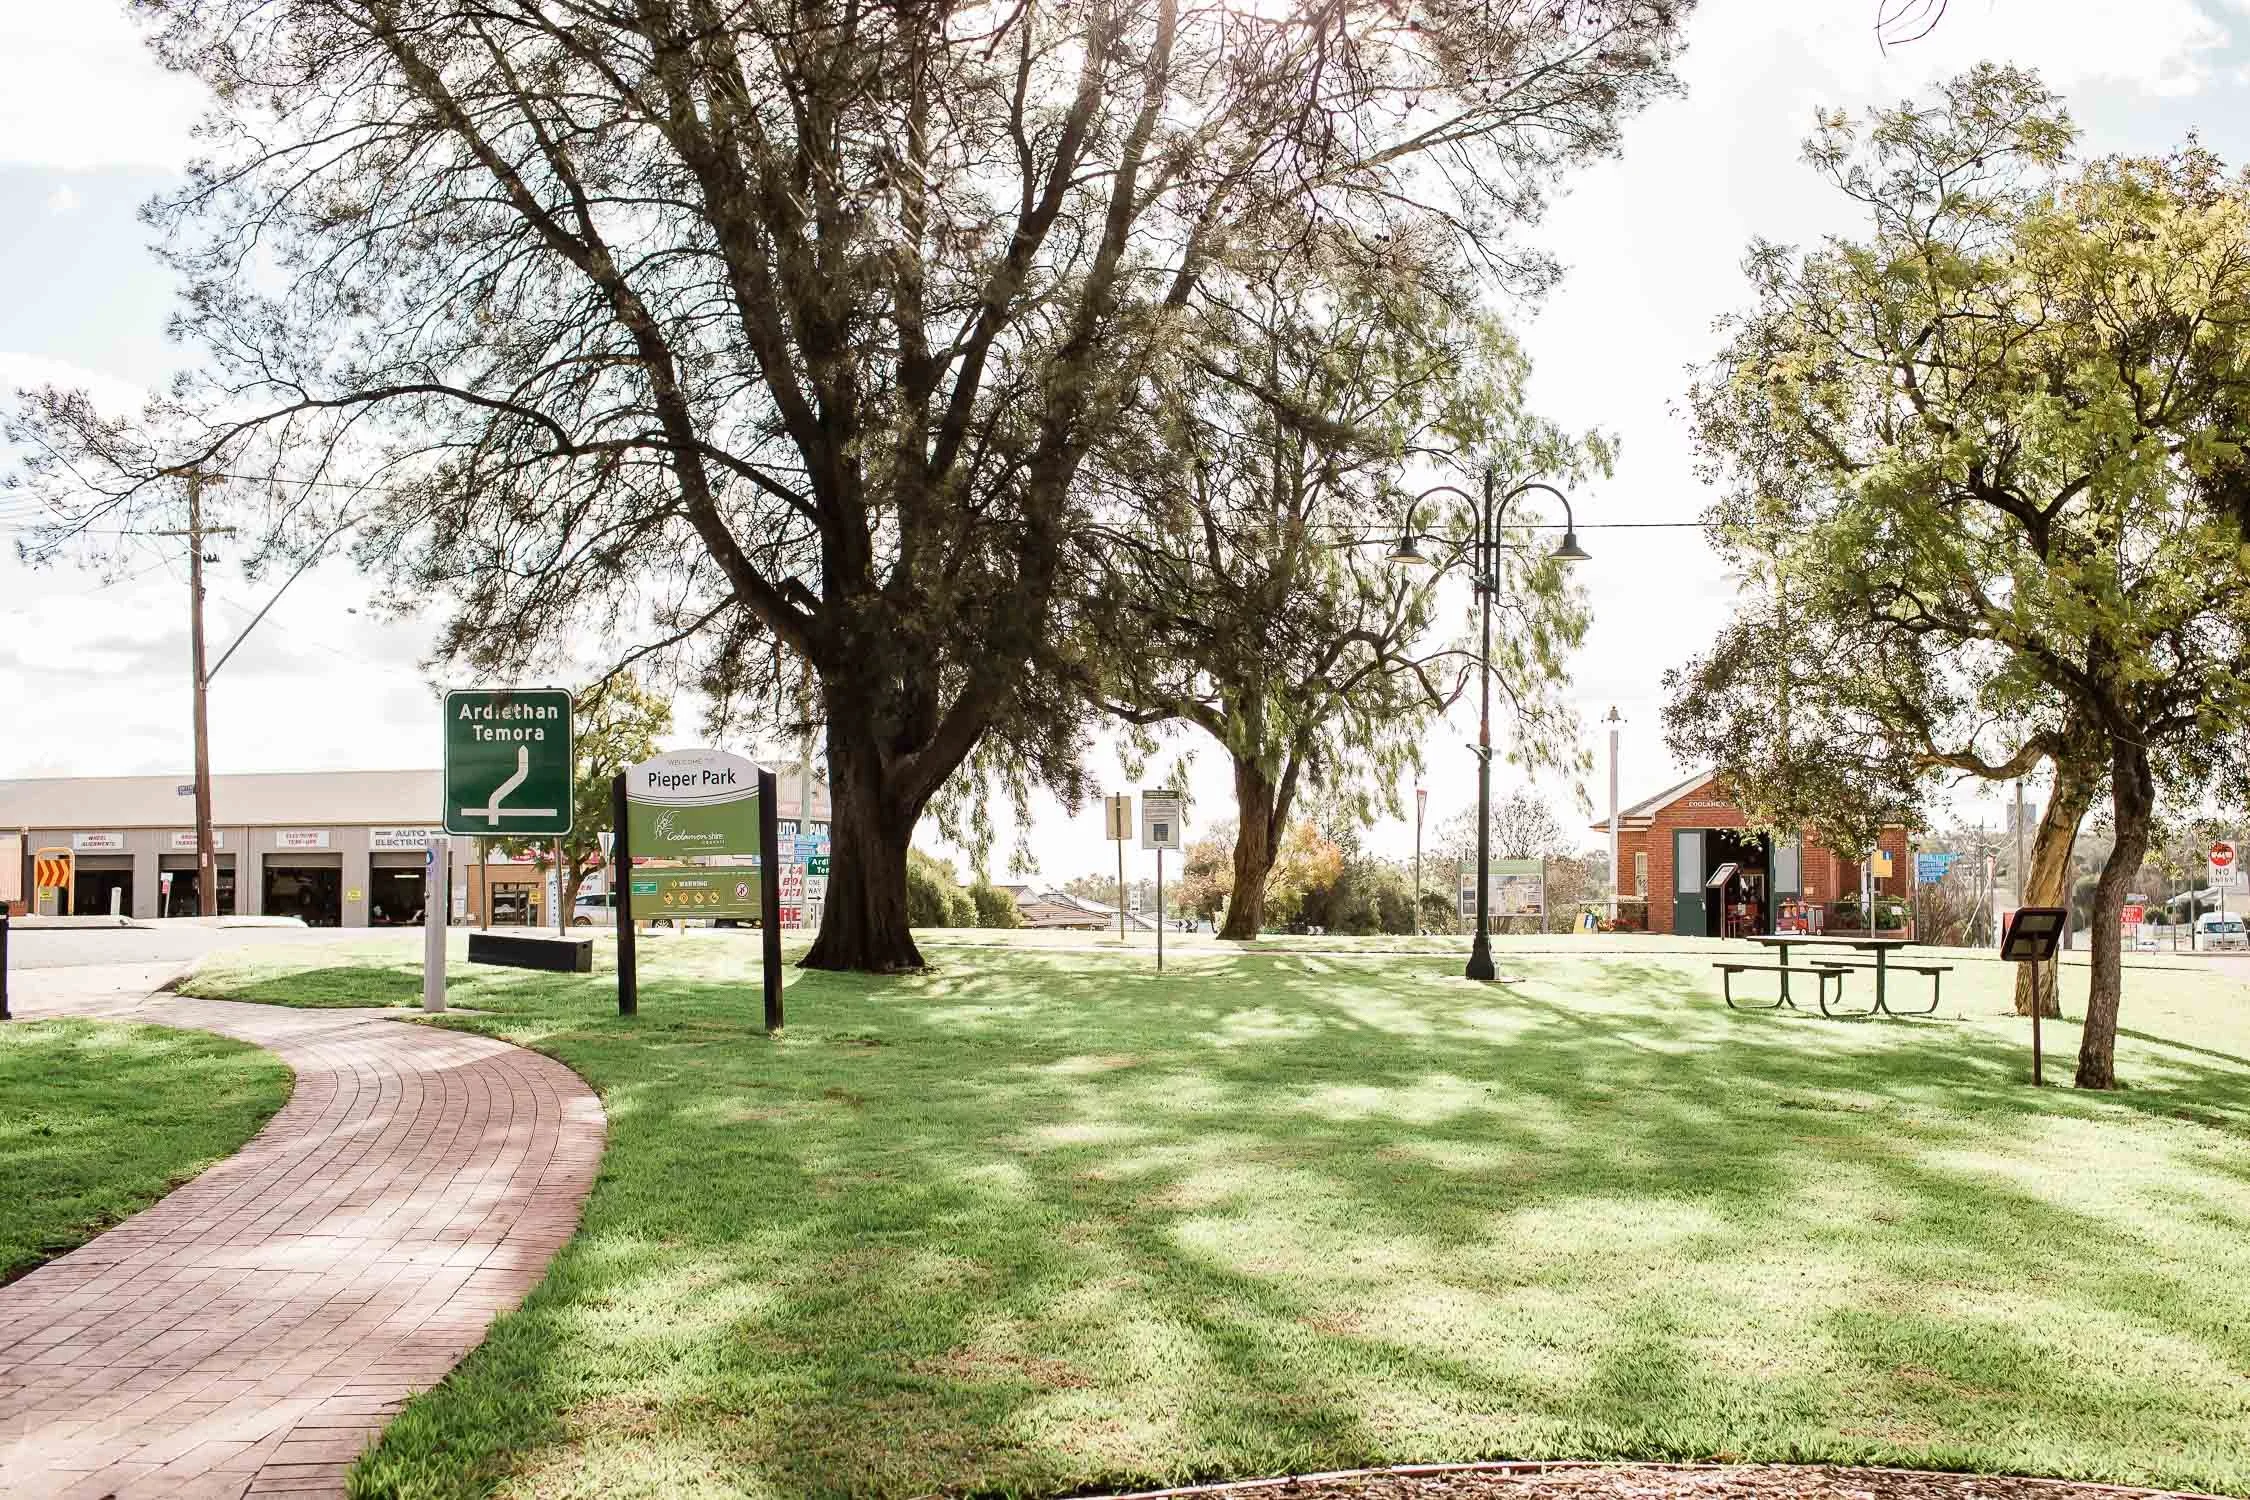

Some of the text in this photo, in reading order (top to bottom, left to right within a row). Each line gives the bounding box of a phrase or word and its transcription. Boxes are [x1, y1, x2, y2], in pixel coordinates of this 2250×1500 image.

[473, 724, 545, 741] Temora
[648, 767, 736, 791] Pieper Park
[2216, 868, 2230, 876] NO
